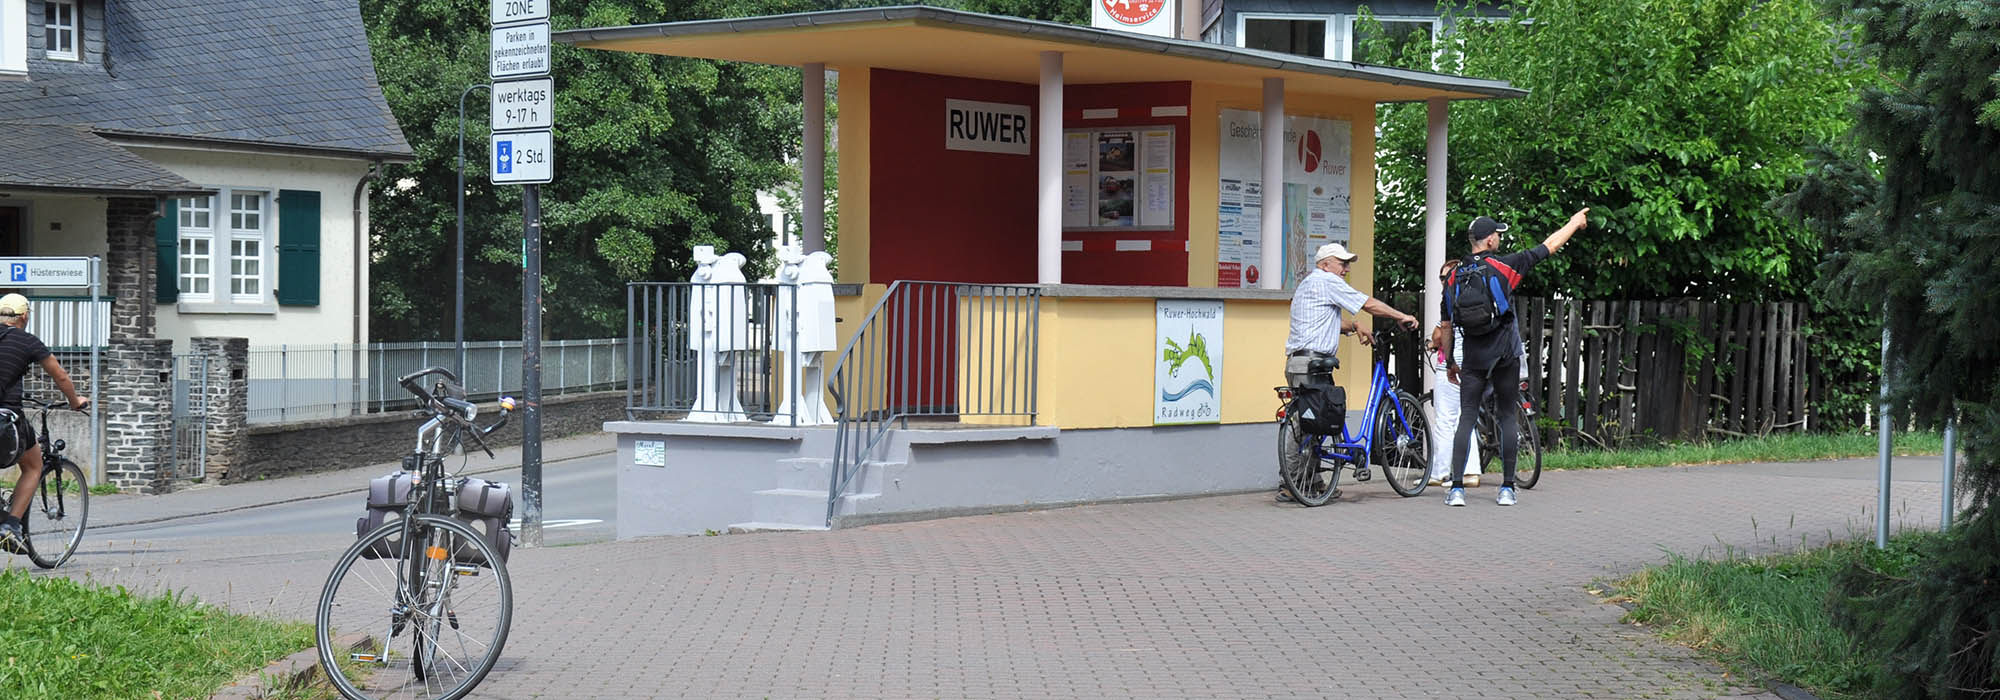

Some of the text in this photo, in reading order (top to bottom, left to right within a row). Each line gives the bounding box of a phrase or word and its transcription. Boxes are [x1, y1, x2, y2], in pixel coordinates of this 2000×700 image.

[505, 0, 534, 17] ZONE
[1110, 8, 1157, 23] Heimservice
[506, 30, 535, 43] Parken in
[494, 44, 546, 61] gekennzeichneten
[497, 57, 544, 72] Flächen erlaubt
[498, 87, 546, 105] werktags
[505, 107, 538, 124] 9-17 h
[950, 109, 1026, 144] RUWER
[516, 148, 546, 164] 2 Std.
[1322, 159, 1347, 176] Ruwer
[14, 264, 84, 281] P Hüsterswiese
[1164, 307, 1217, 320] Ruwer-Hochwald
[1161, 406, 1196, 420] Radweg
